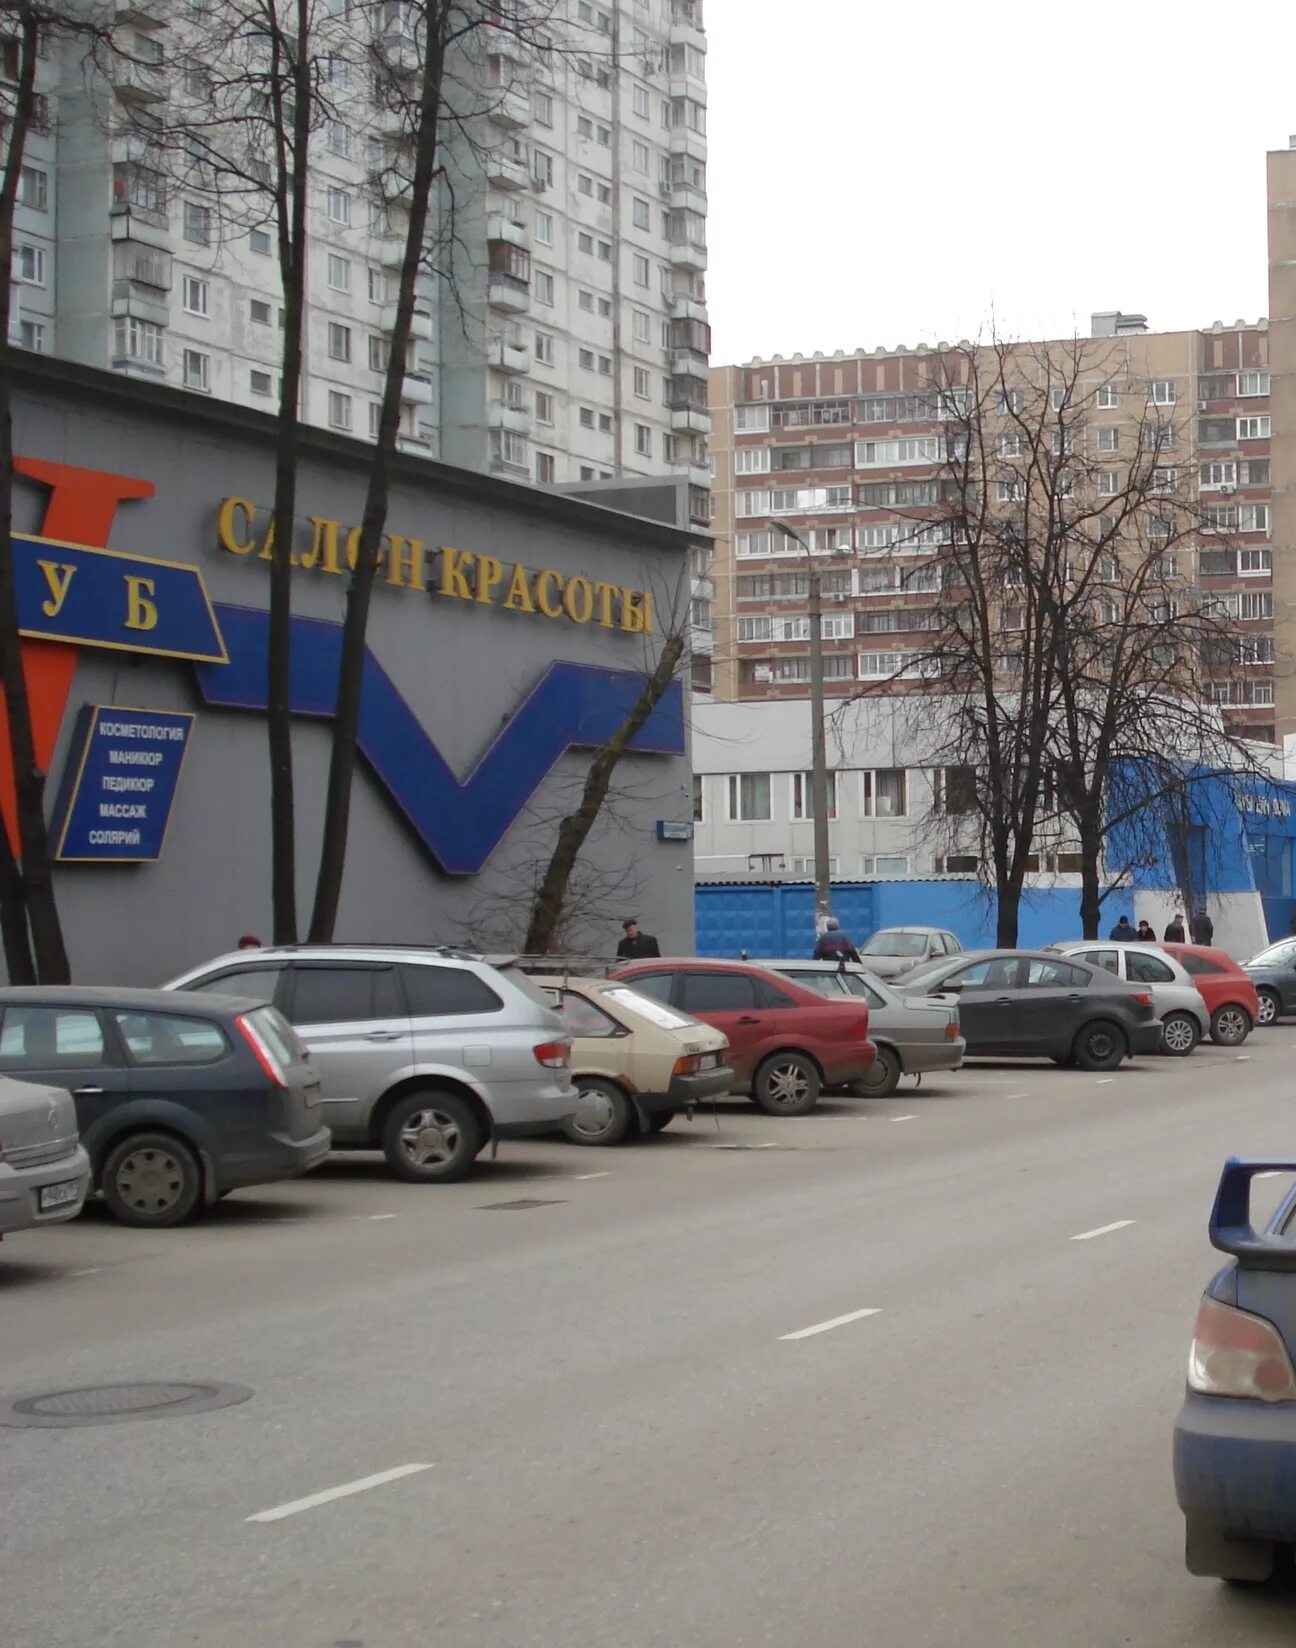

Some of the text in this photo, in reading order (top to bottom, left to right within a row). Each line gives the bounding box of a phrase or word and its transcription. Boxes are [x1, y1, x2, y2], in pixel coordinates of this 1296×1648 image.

[437, 546, 655, 634] КРАСОТЫ
[100, 722, 184, 741] КОСМЕТОЛОГИЯ
[109, 750, 163, 766] МАНИКЮР
[102, 776, 154, 793] ПЕДИКЮР
[99, 803, 147, 819] МАССАЖ
[89, 829, 141, 845] СОЛЯРИЙ
